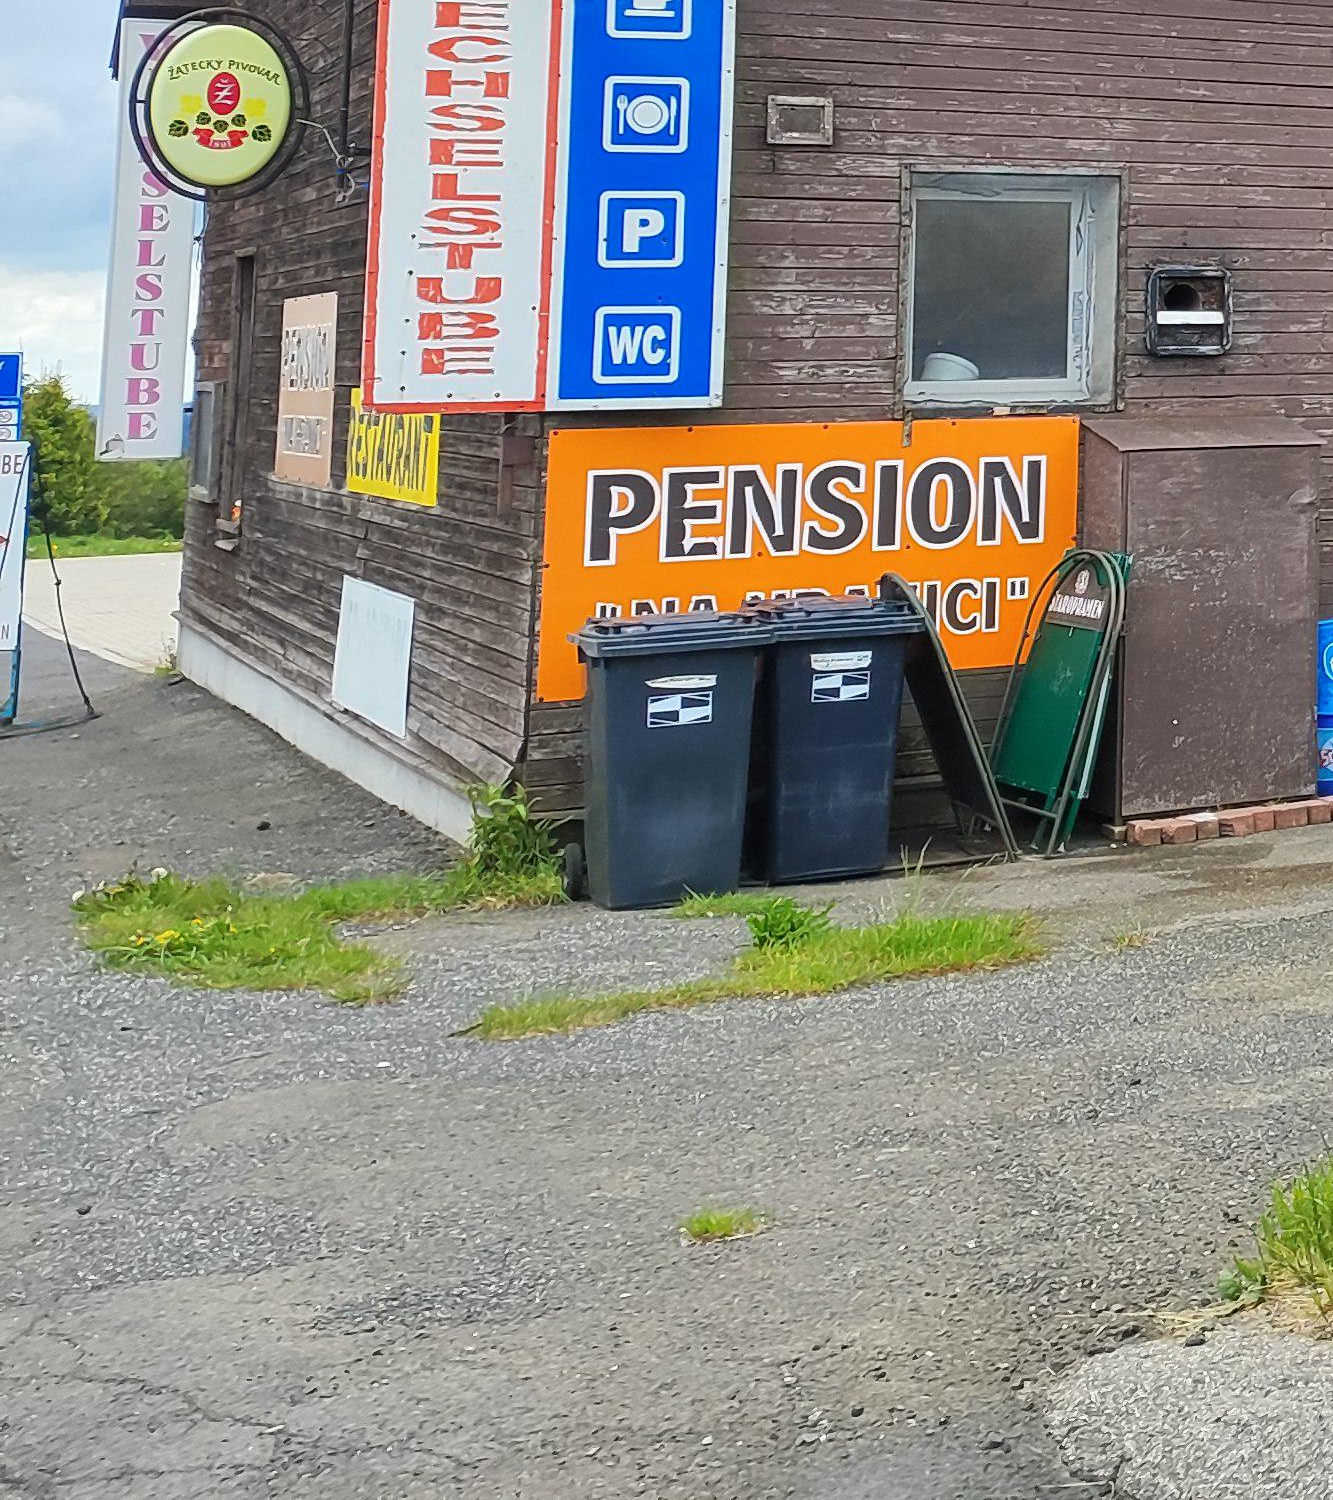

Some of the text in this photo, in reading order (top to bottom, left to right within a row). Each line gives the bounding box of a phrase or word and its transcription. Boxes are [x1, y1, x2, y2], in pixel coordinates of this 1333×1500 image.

[228, 59, 282, 86] PIVOVAR
[622, 209, 666, 254] P
[608, 325, 666, 365] WC
[583, 455, 1047, 567] PENSION
